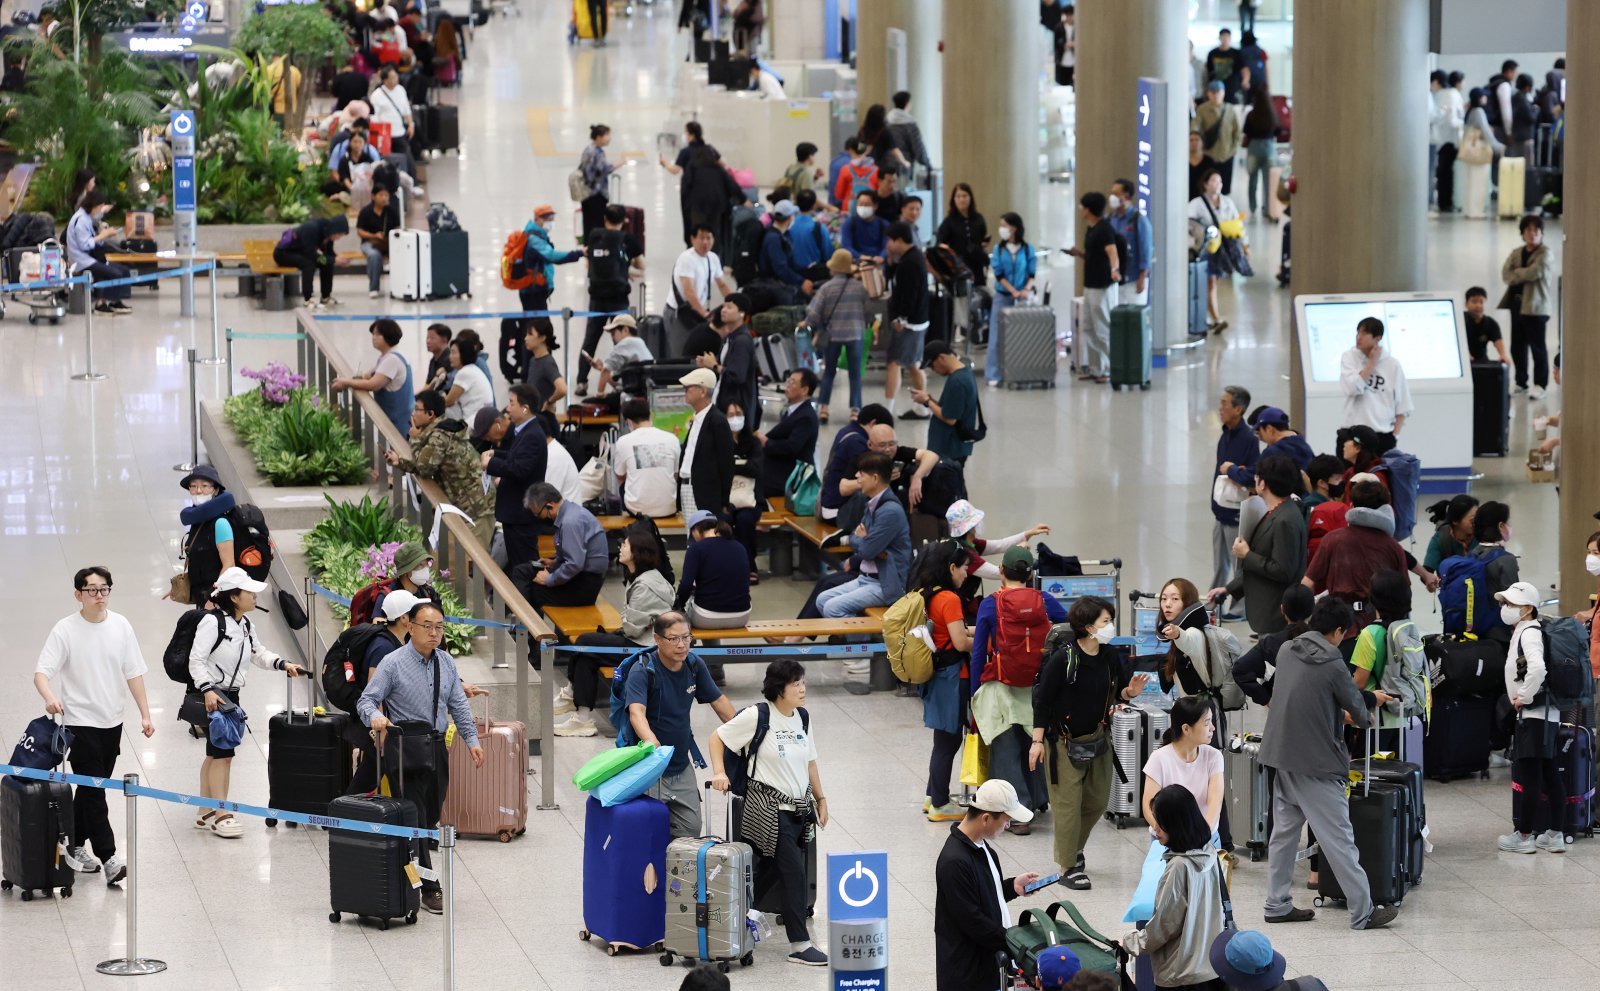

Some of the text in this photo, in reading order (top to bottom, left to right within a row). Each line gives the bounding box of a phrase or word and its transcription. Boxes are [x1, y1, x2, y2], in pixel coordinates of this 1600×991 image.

[308, 815, 340, 827] SECURITY
[841, 932, 884, 945] CHARGE
[839, 978, 881, 988] Free Charging
